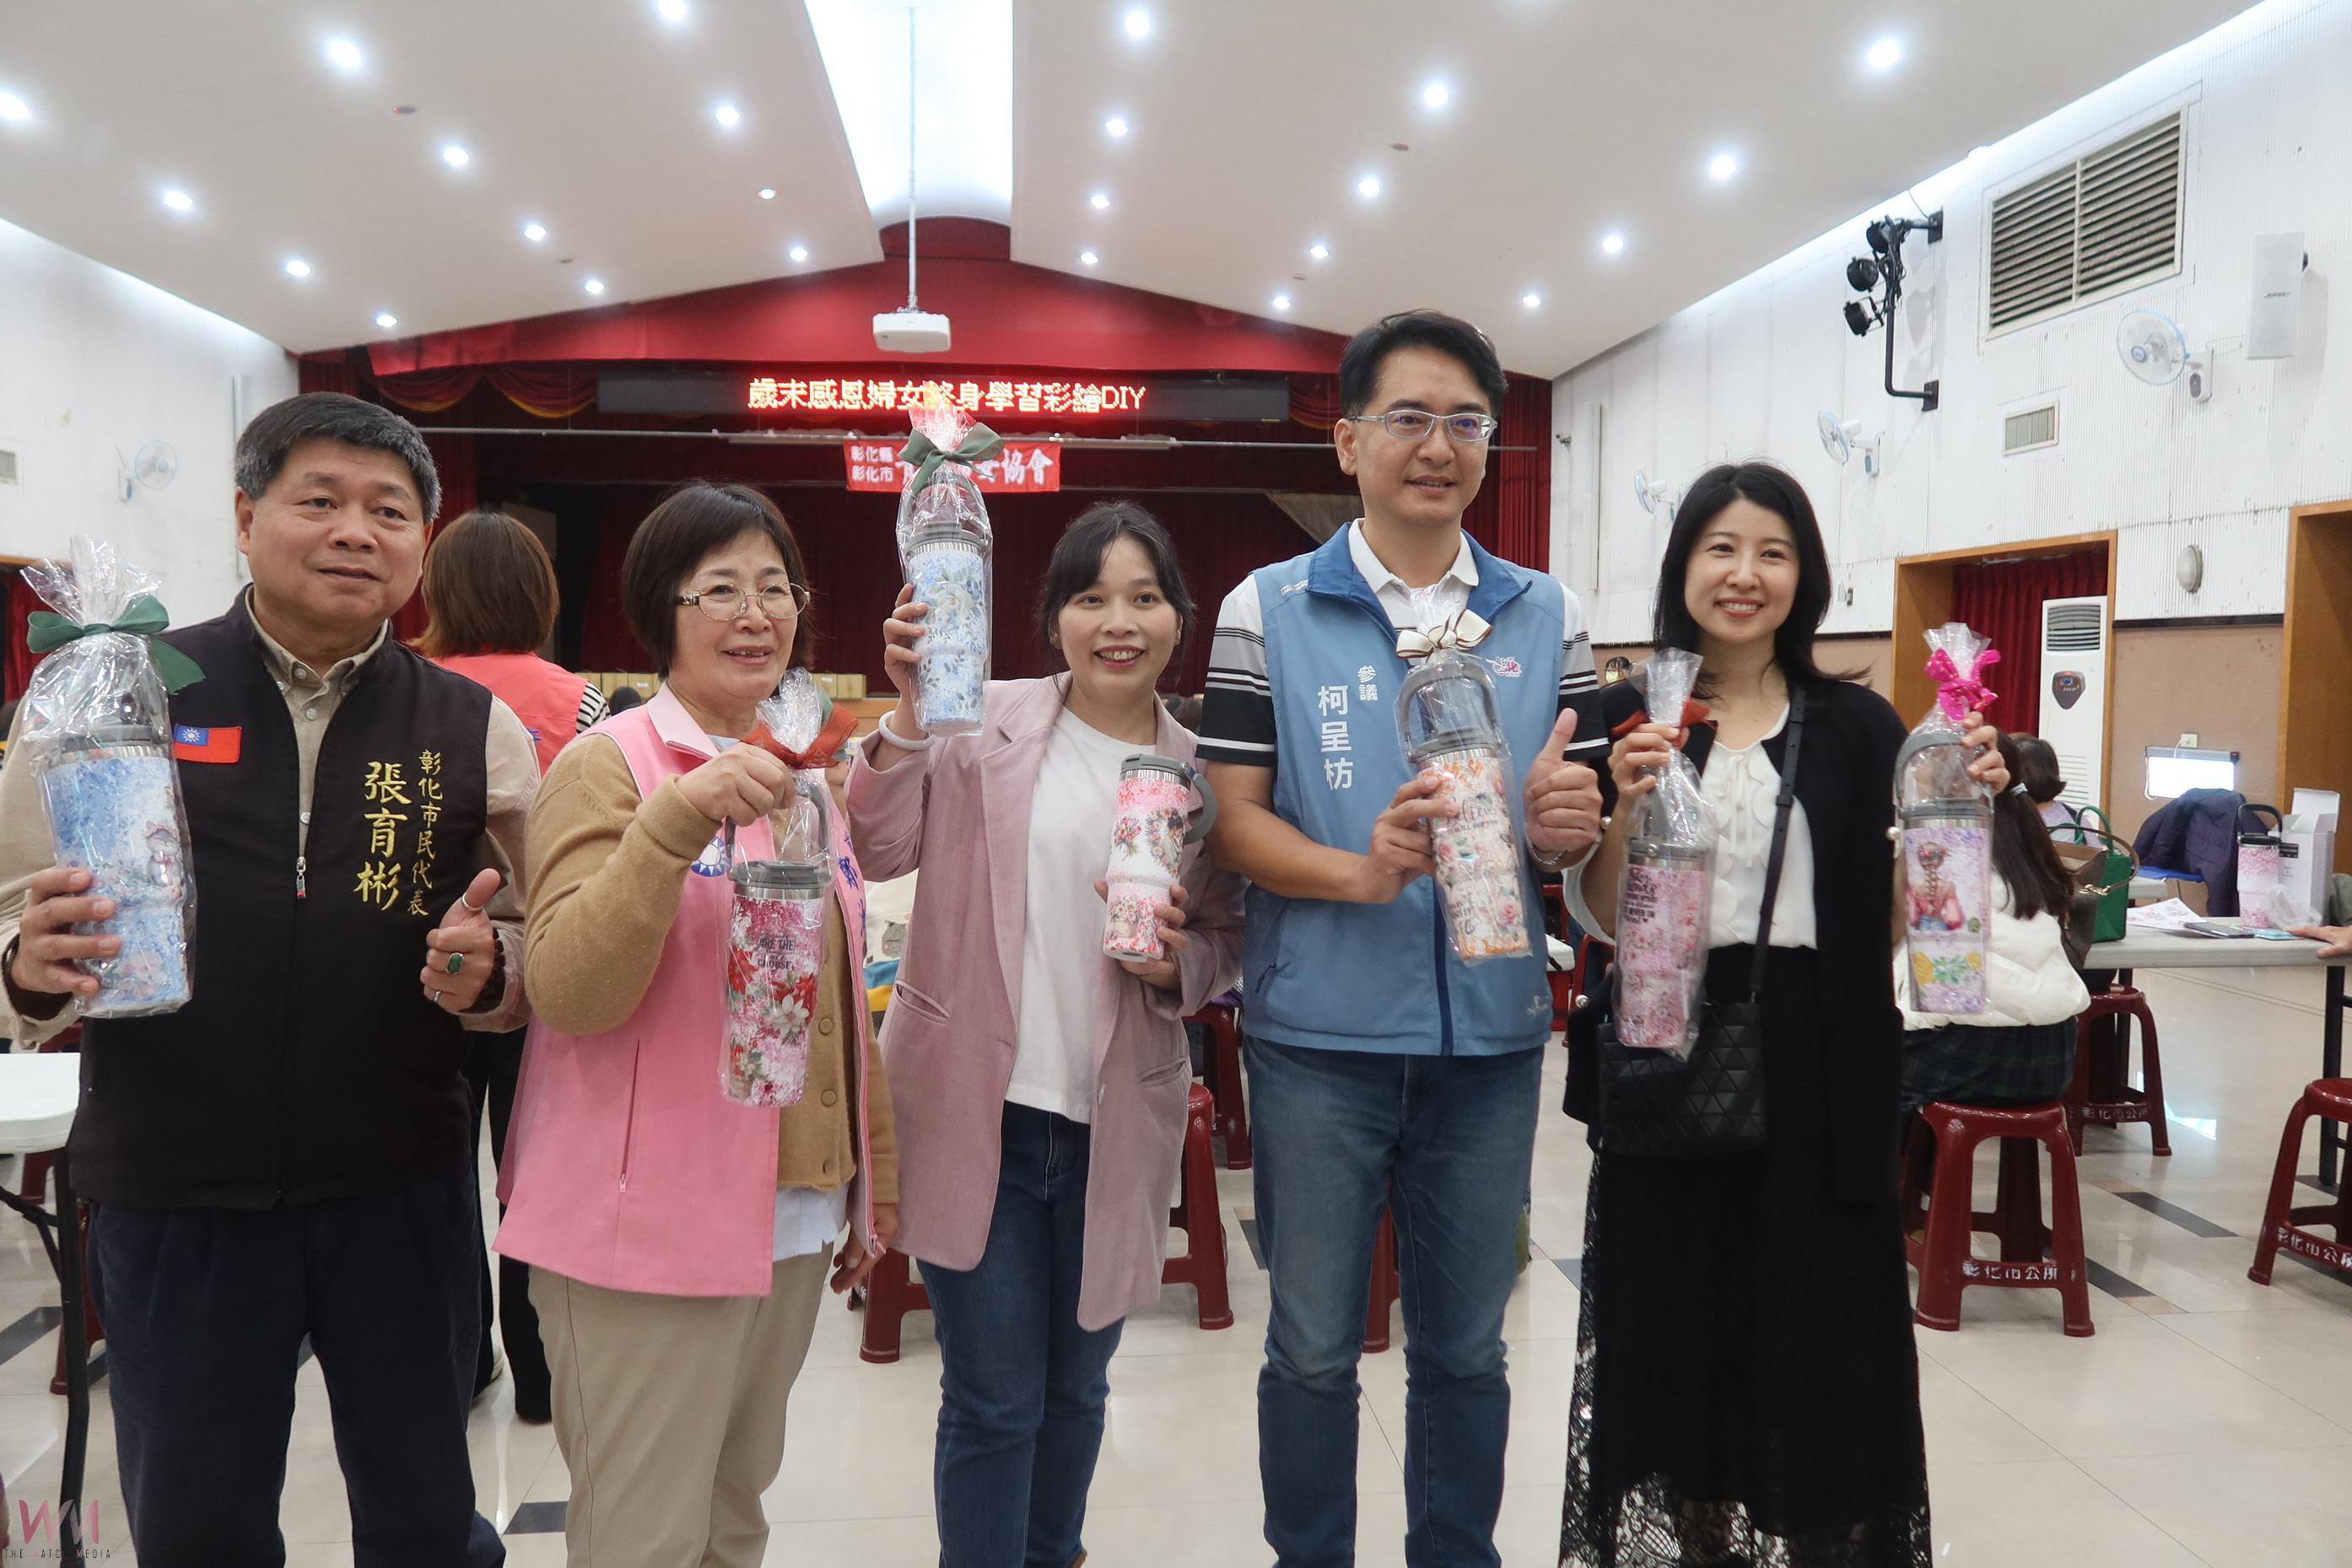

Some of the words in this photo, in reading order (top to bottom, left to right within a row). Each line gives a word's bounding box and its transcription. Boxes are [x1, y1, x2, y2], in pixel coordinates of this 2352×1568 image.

[850, 445, 893, 462] 彰化縣
[851, 465, 893, 482] 彰化市
[1357, 665, 1379, 702] 參議
[1317, 684, 1354, 791] 柯呈枋
[353, 761, 413, 911] 張育彬
[407, 748, 444, 916] 彰化市民代表
